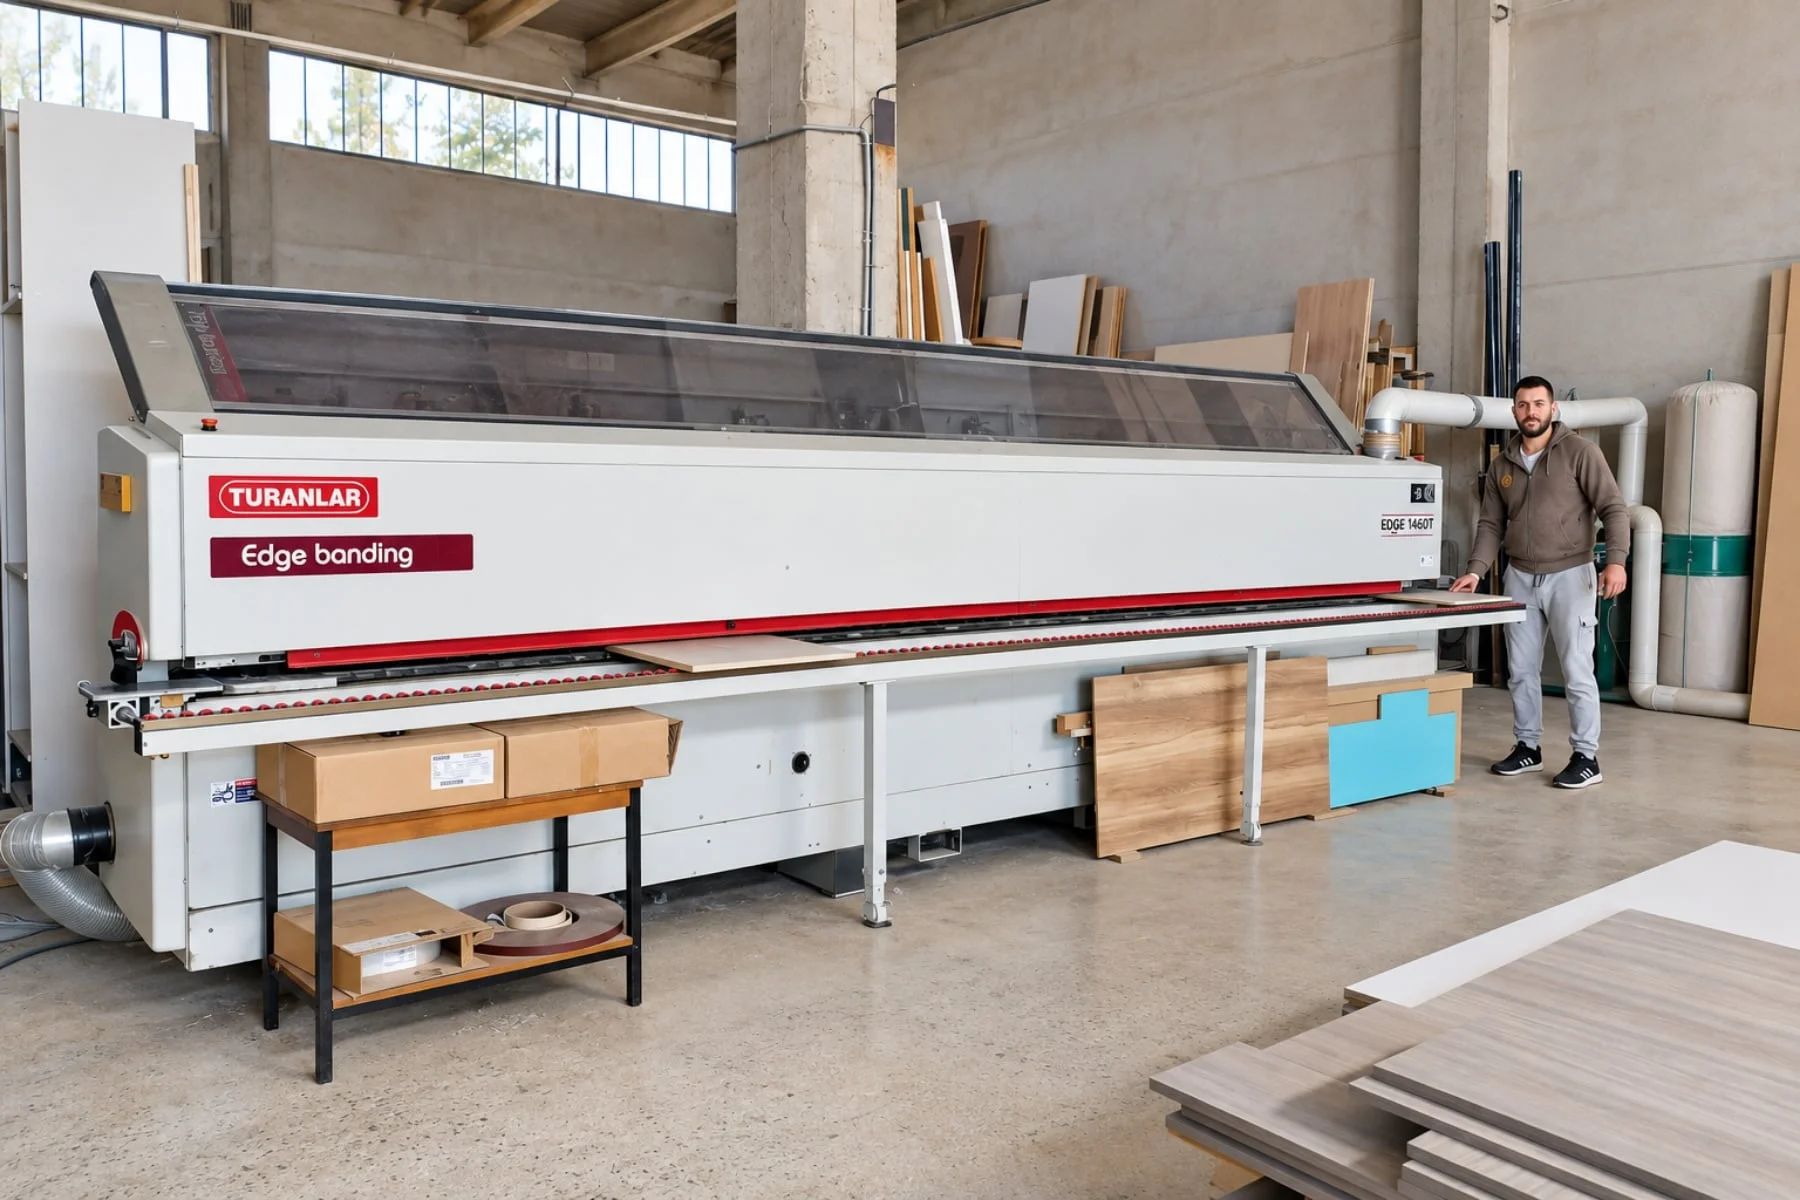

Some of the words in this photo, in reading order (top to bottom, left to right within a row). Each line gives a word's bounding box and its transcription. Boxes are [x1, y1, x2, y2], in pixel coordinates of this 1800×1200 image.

[229, 488, 361, 507] TURANLAR
[1381, 518, 1405, 530] EDGE
[1408, 518, 1434, 530] 1460T
[241, 544, 307, 572] Edge
[315, 542, 413, 568] banding
